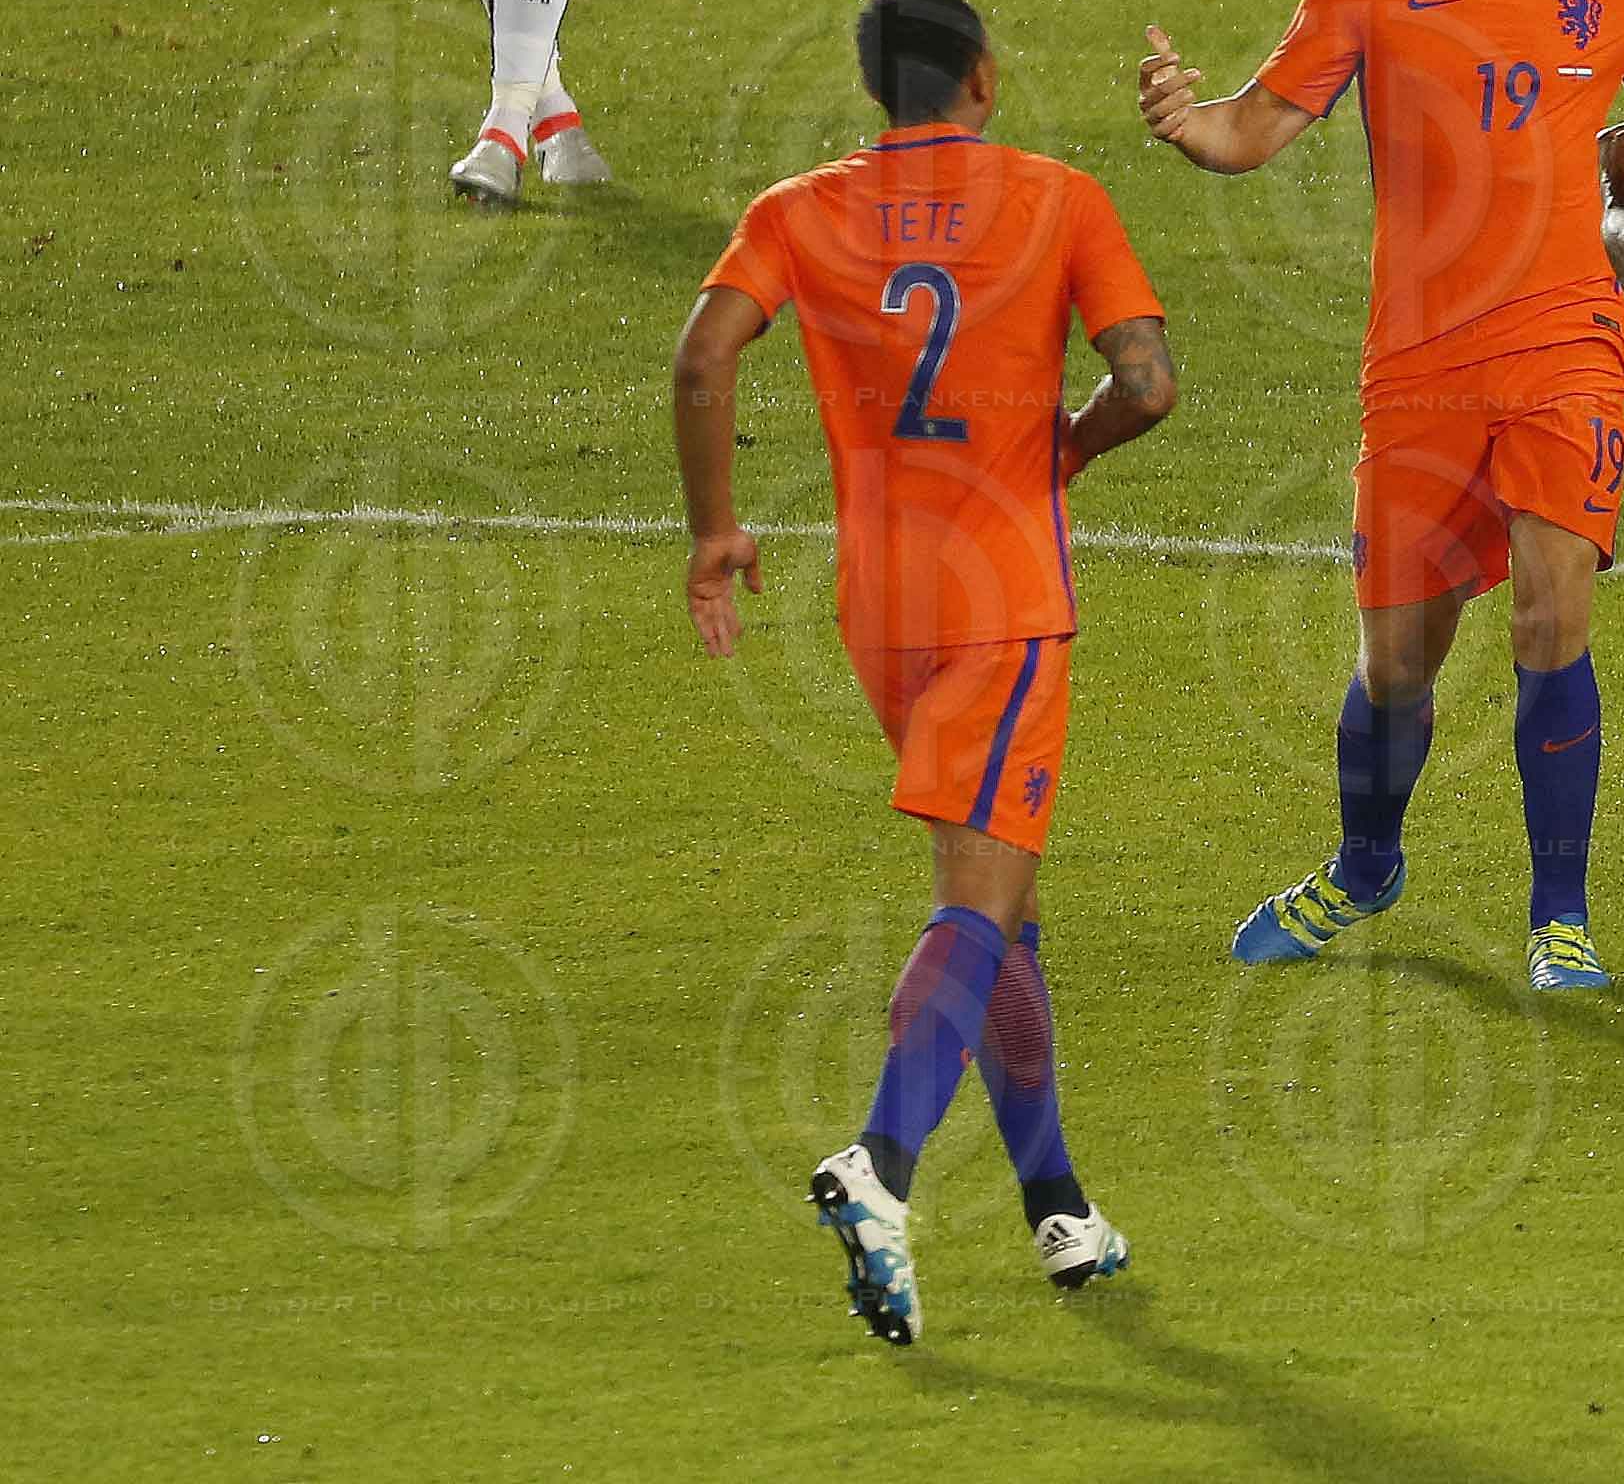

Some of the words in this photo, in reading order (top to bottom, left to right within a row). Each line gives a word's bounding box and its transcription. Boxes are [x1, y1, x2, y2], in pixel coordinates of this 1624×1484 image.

[1476, 61, 1542, 133] 19
[877, 202, 967, 245] TETE
[880, 260, 969, 444] 2
